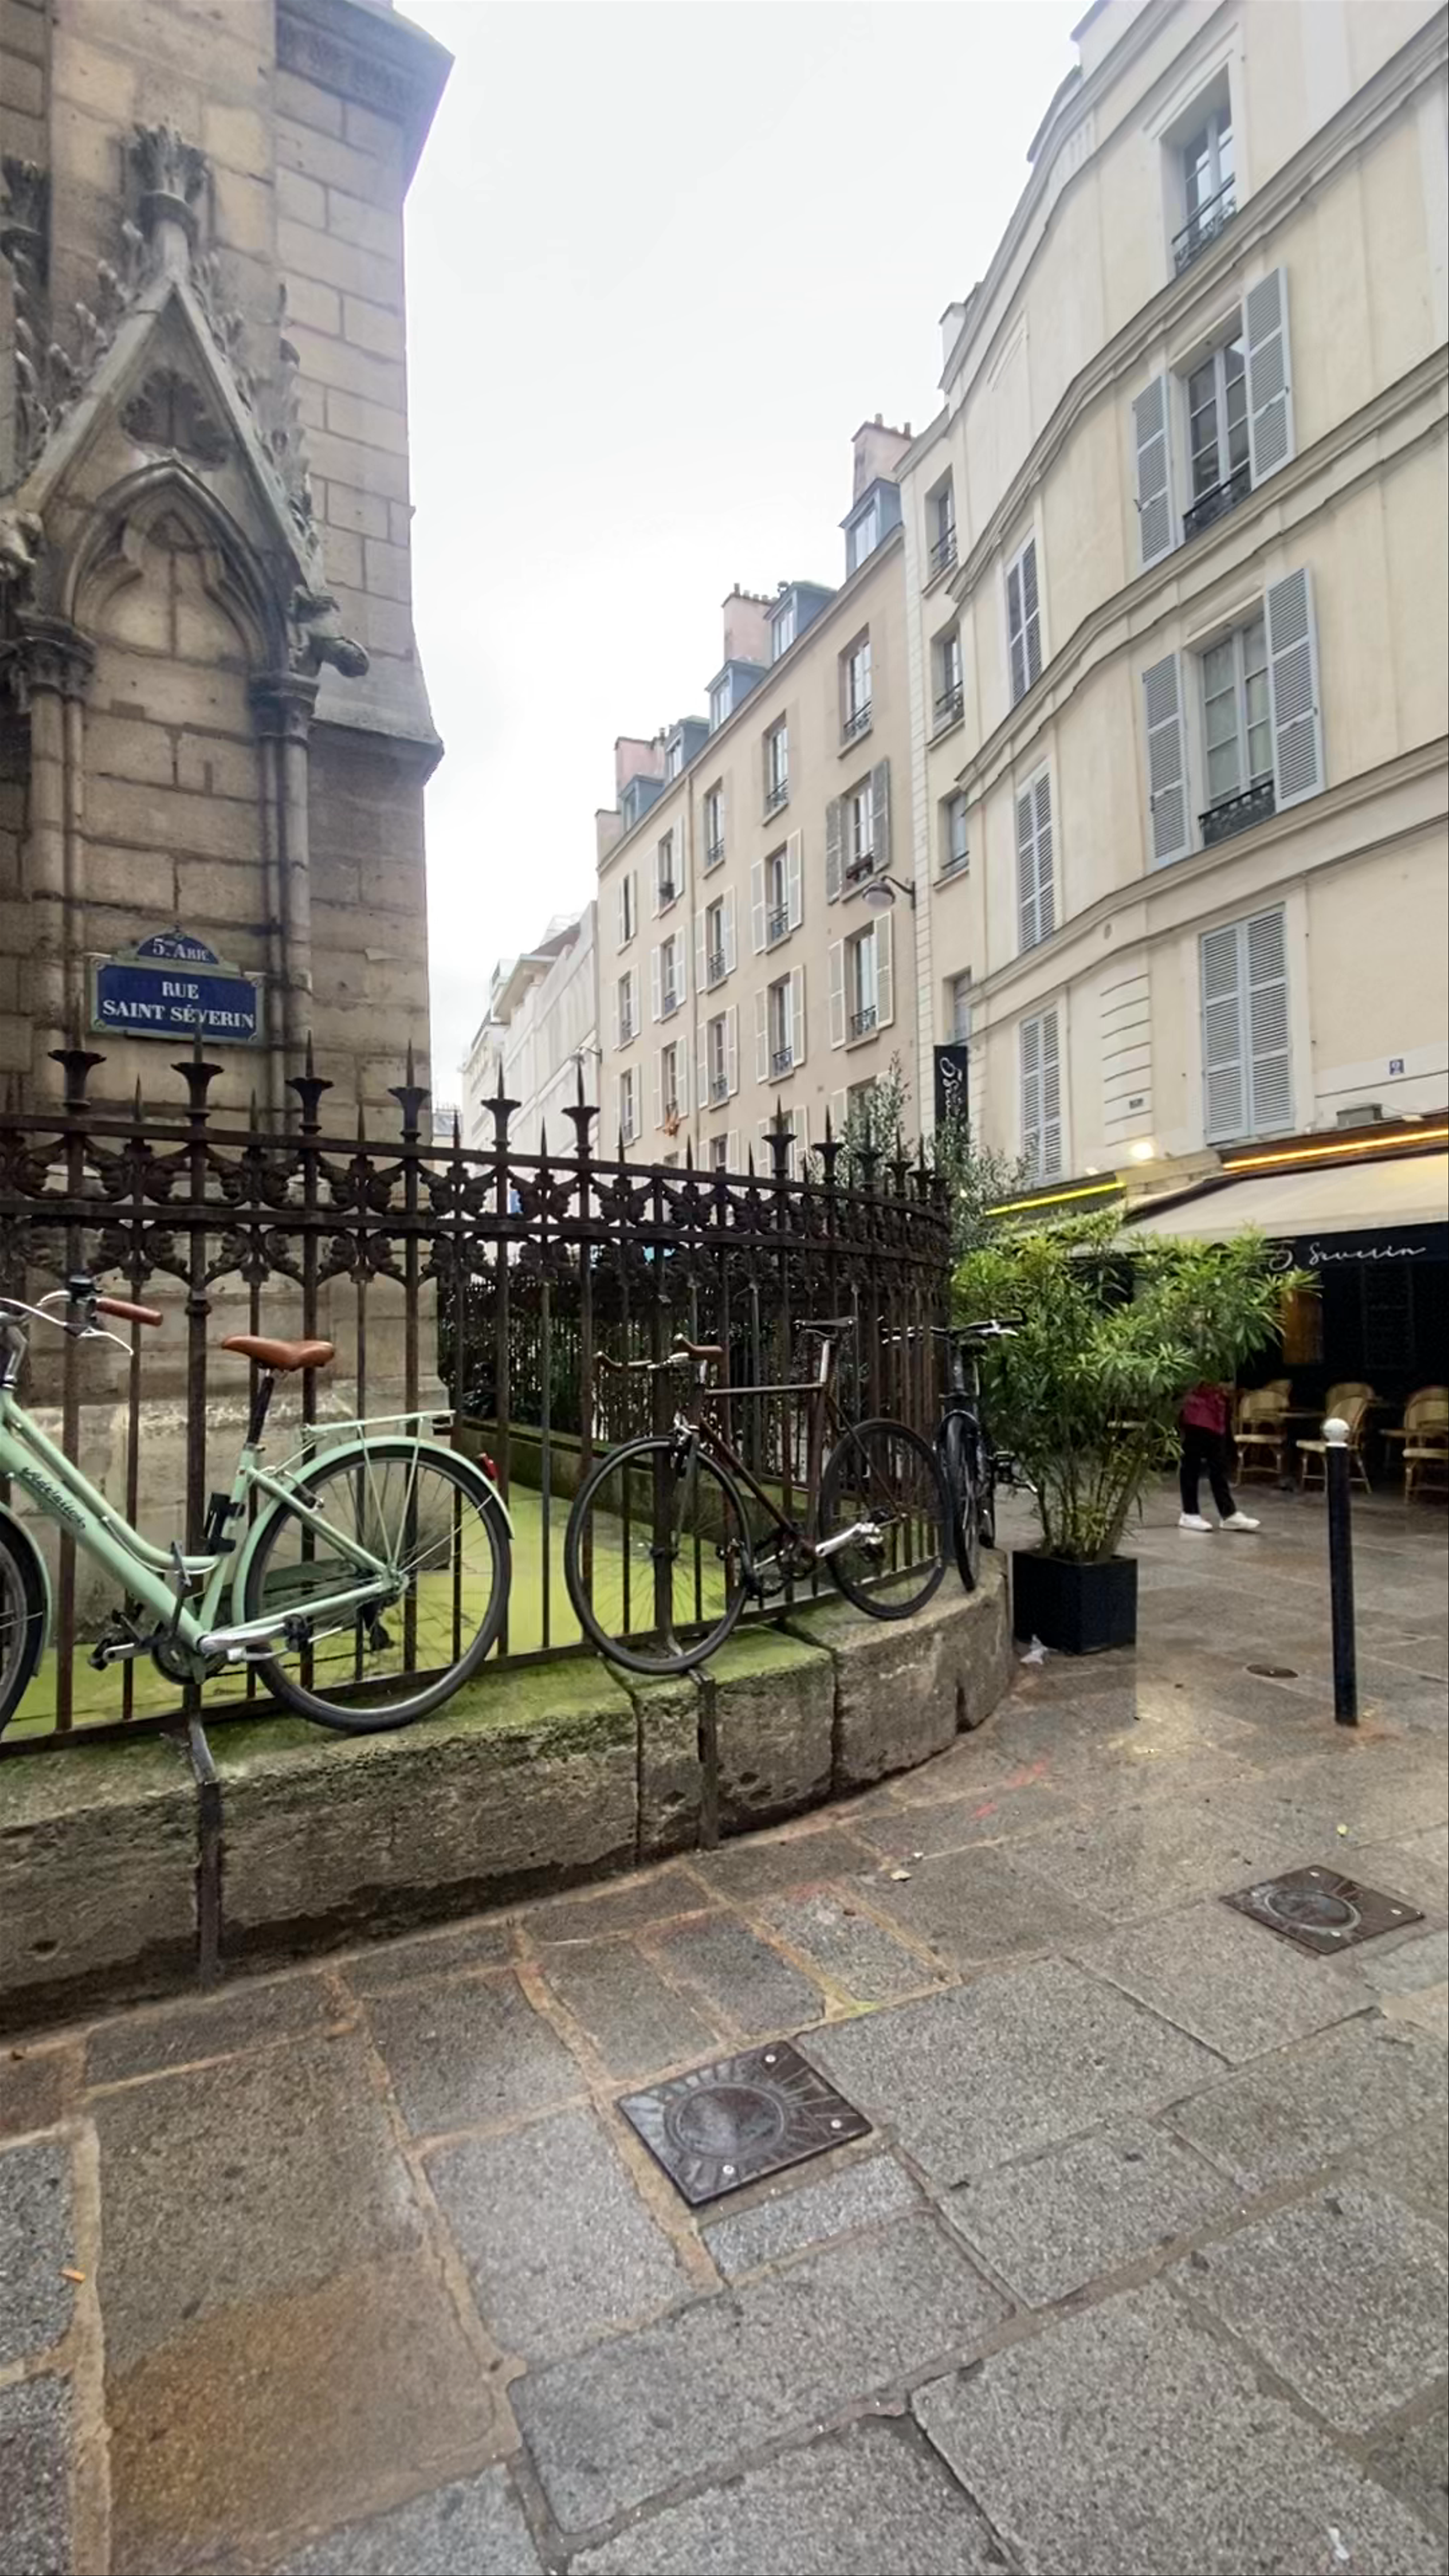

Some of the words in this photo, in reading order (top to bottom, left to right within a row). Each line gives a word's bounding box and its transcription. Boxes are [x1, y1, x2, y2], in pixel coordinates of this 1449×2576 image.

[162, 981, 198, 999] RUE
[103, 1000, 165, 1020] SAINT
[171, 1005, 253, 1028] SÉVERIN
